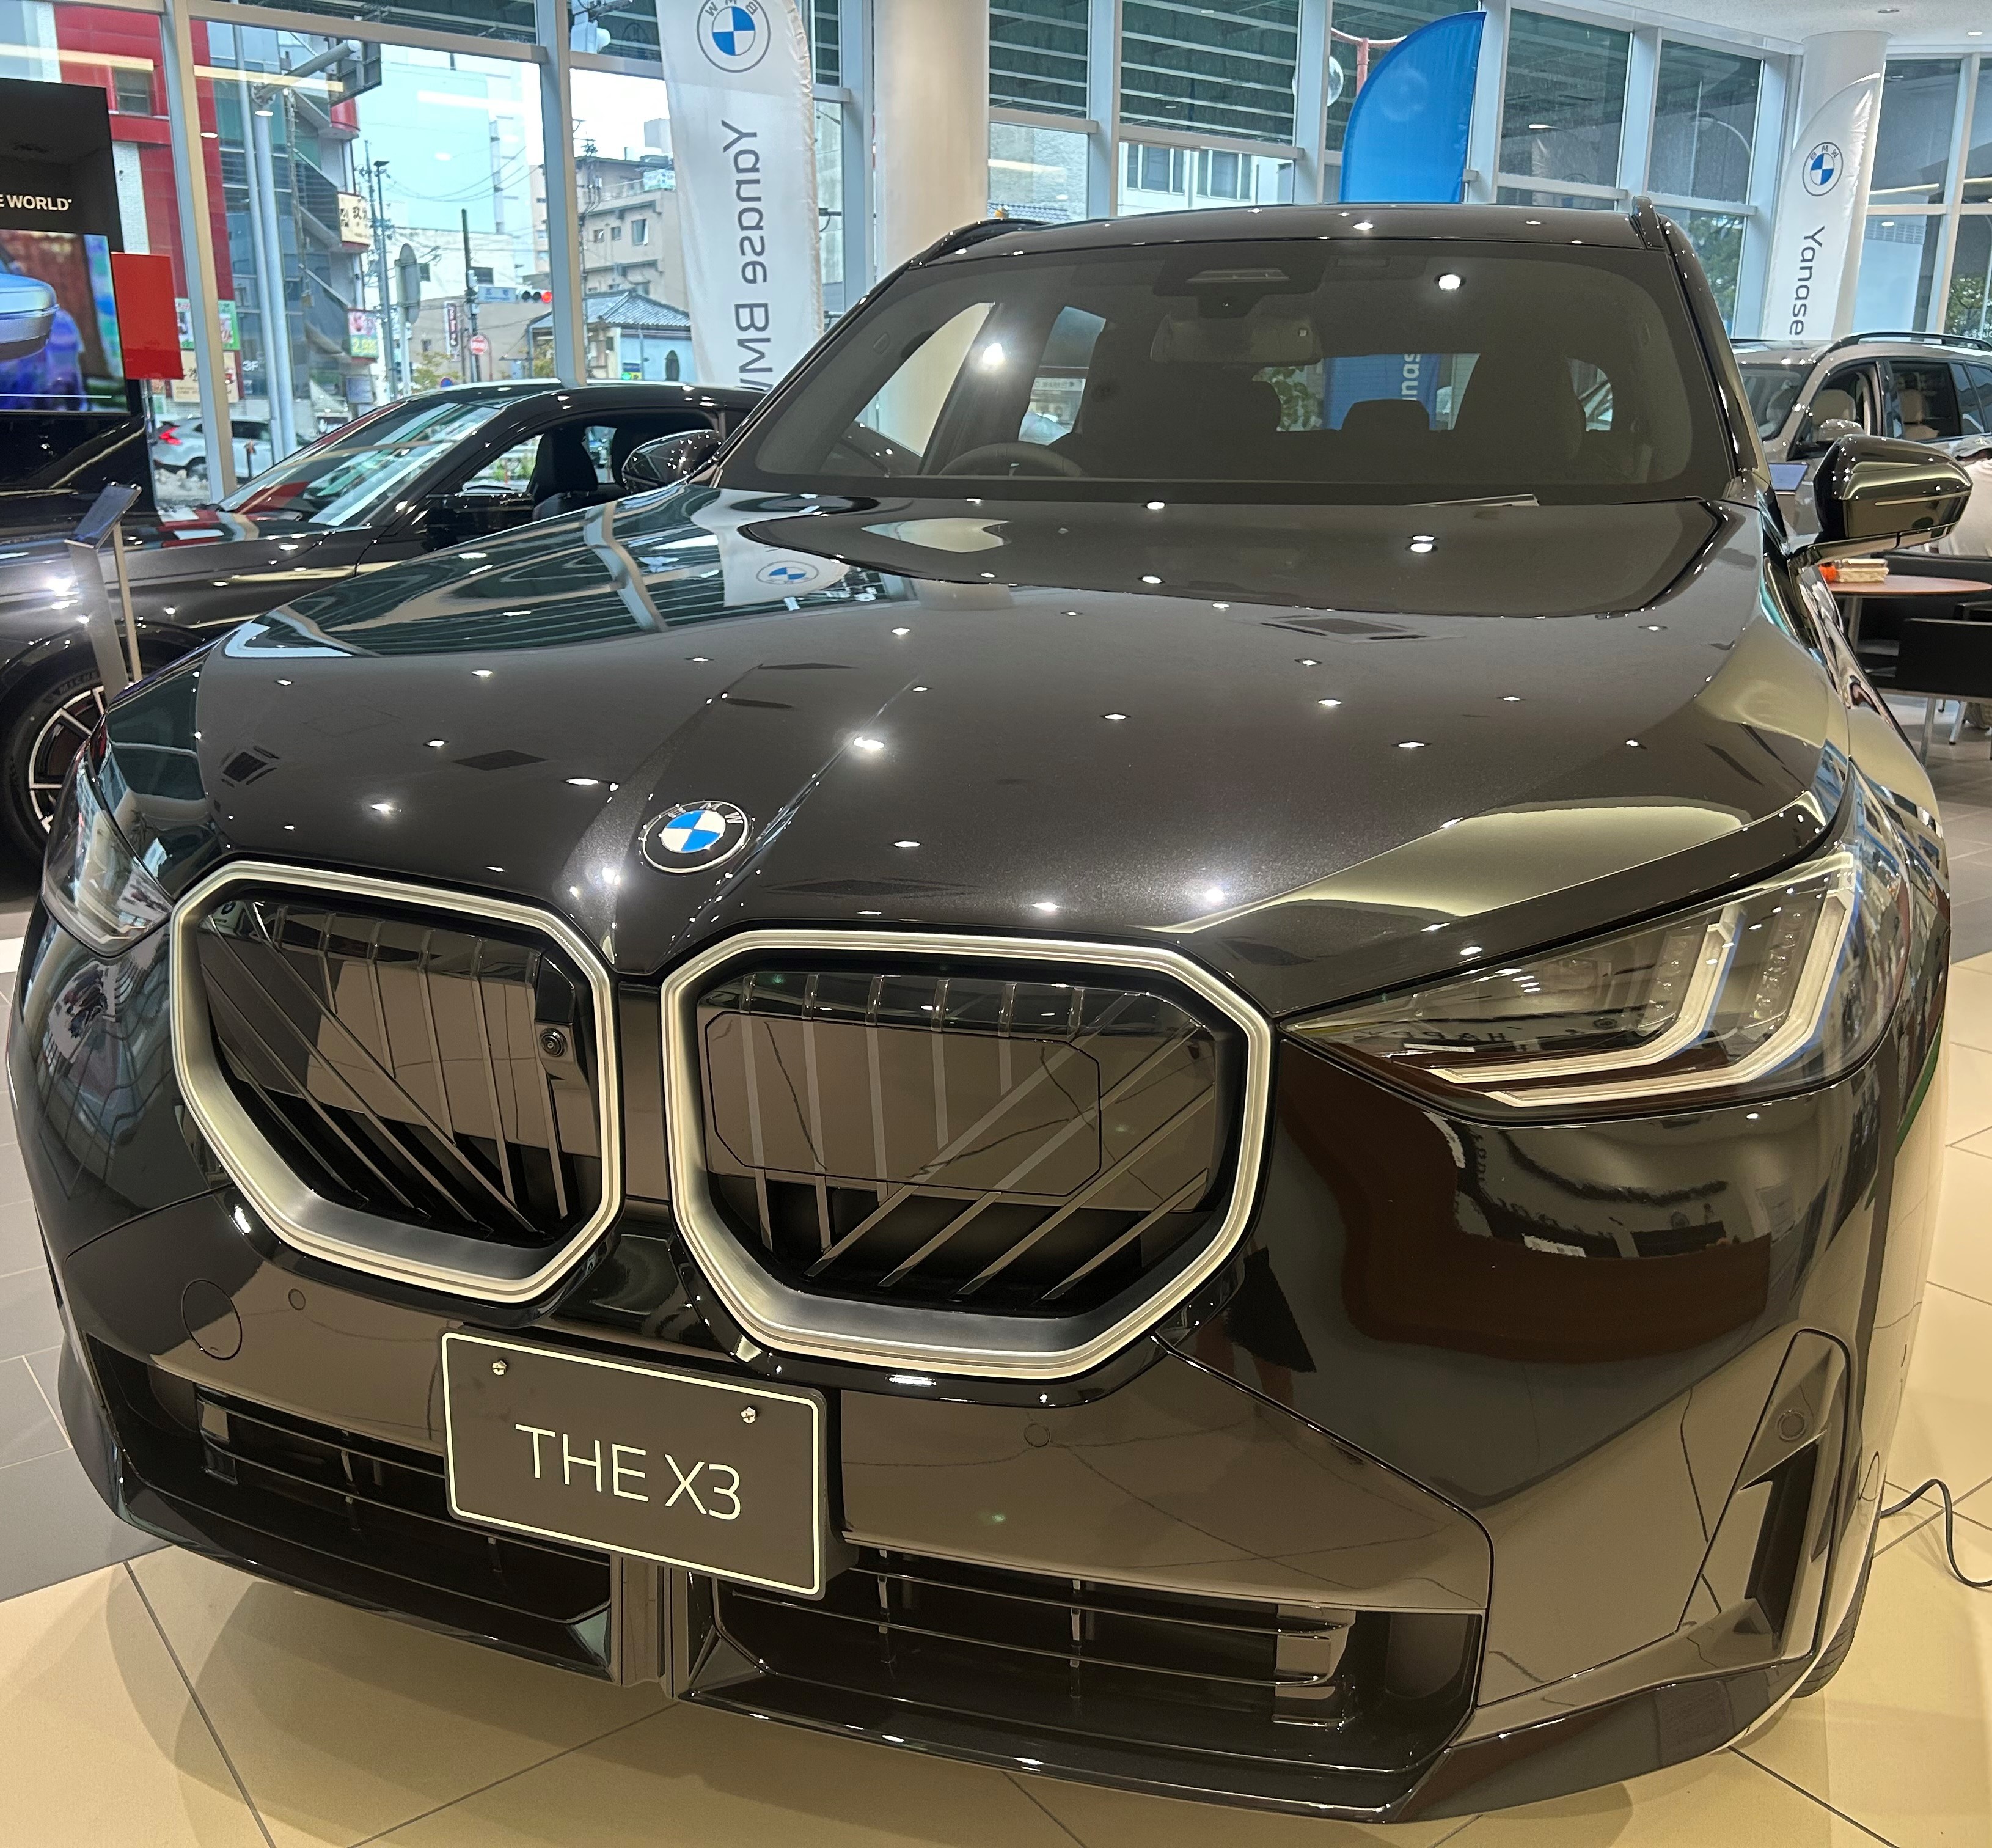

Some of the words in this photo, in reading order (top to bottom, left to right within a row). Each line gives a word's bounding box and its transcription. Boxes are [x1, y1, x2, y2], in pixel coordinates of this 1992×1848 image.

[1789, 226, 1825, 336] Yanase
[668, 802, 744, 824] BMW
[515, 1423, 649, 1502] THE
[664, 1454, 741, 1520] X3
